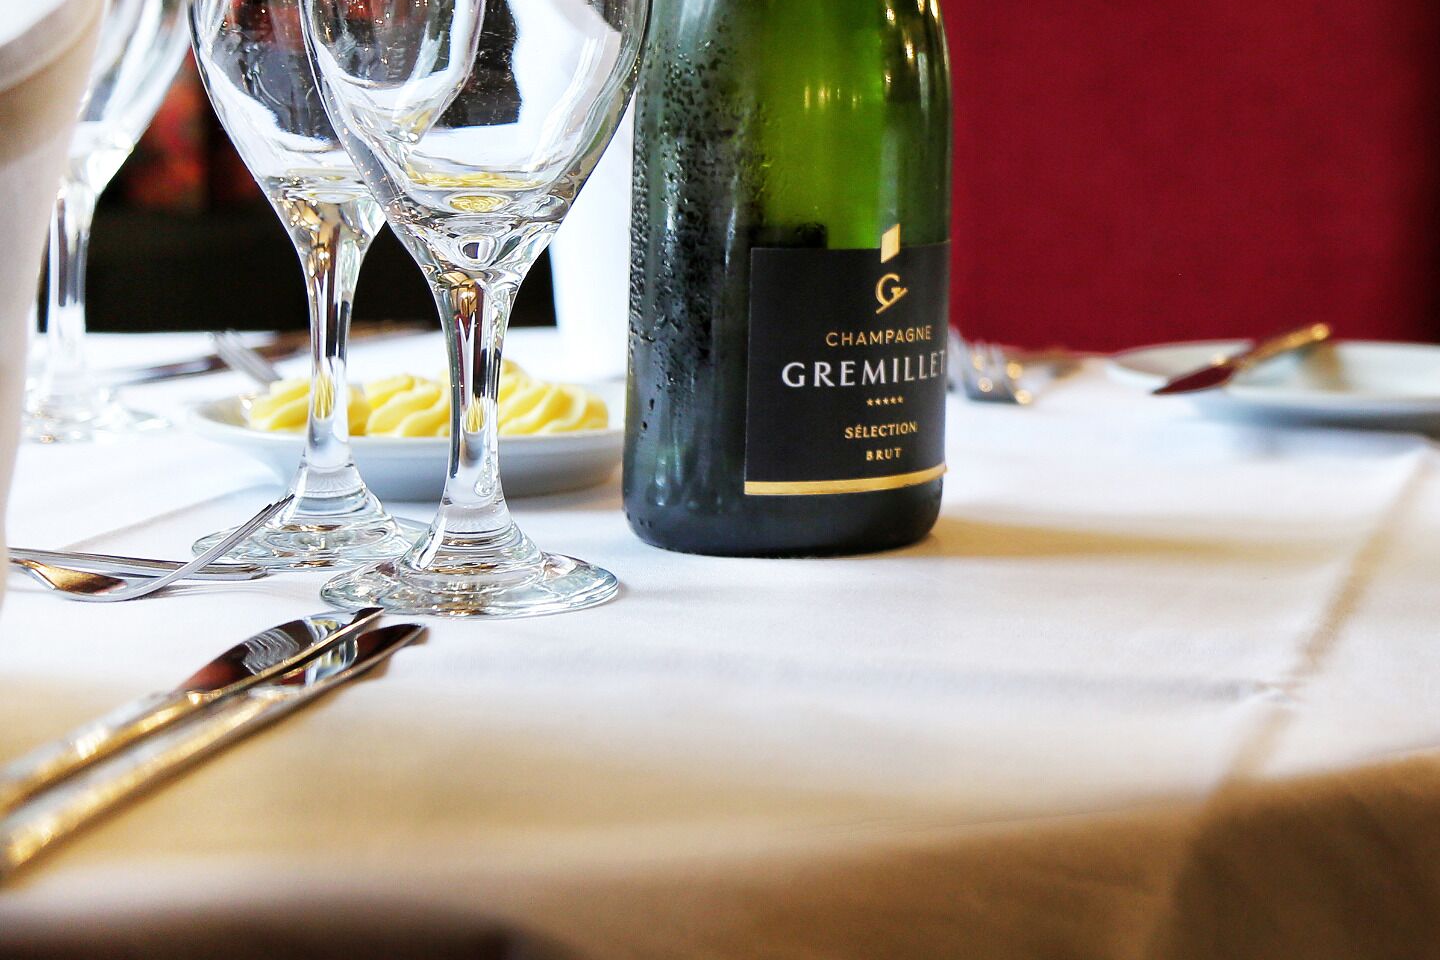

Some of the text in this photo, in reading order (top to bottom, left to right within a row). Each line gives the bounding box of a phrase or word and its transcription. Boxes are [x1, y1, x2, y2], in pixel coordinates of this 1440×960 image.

[875, 273, 908, 314] G
[825, 325, 932, 347] CHAMPAGNE
[781, 349, 946, 387] GREMILLET
[844, 421, 918, 439] SÉLECTION
[865, 447, 902, 461] BRUT
